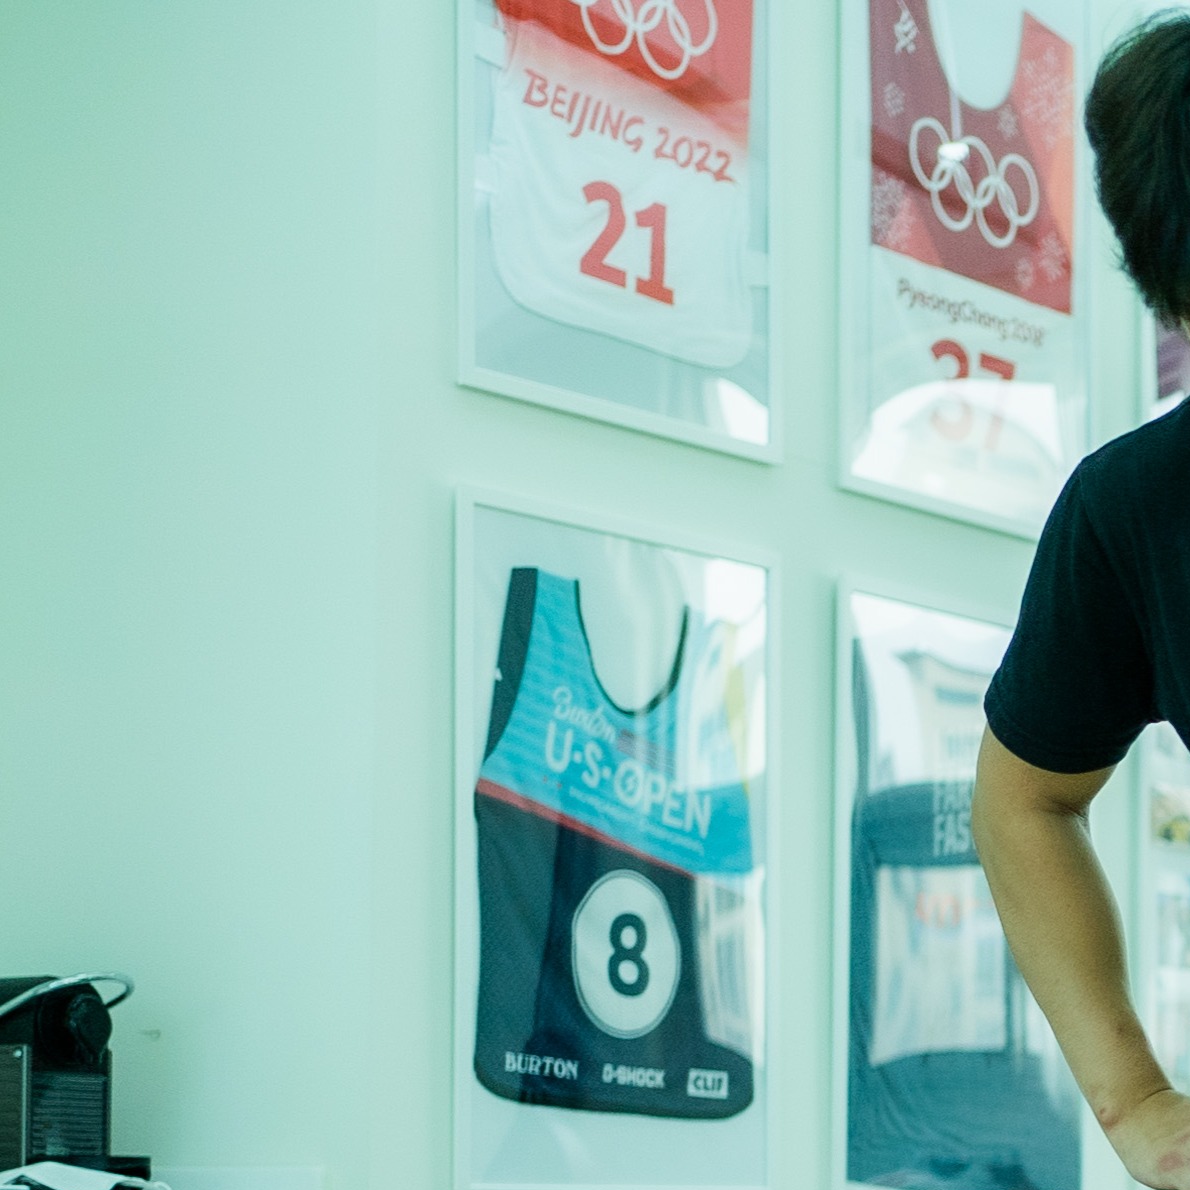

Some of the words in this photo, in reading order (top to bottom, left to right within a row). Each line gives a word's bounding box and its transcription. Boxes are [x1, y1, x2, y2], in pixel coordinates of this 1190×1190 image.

[523, 68, 645, 152] BEIJING
[653, 126, 738, 183] 2022
[578, 179, 675, 305] 21
[933, 813, 977, 858] FAS
[606, 912, 650, 997] 8
[504, 1051, 580, 1081] BURTON
[692, 1074, 724, 1092] CLIF
